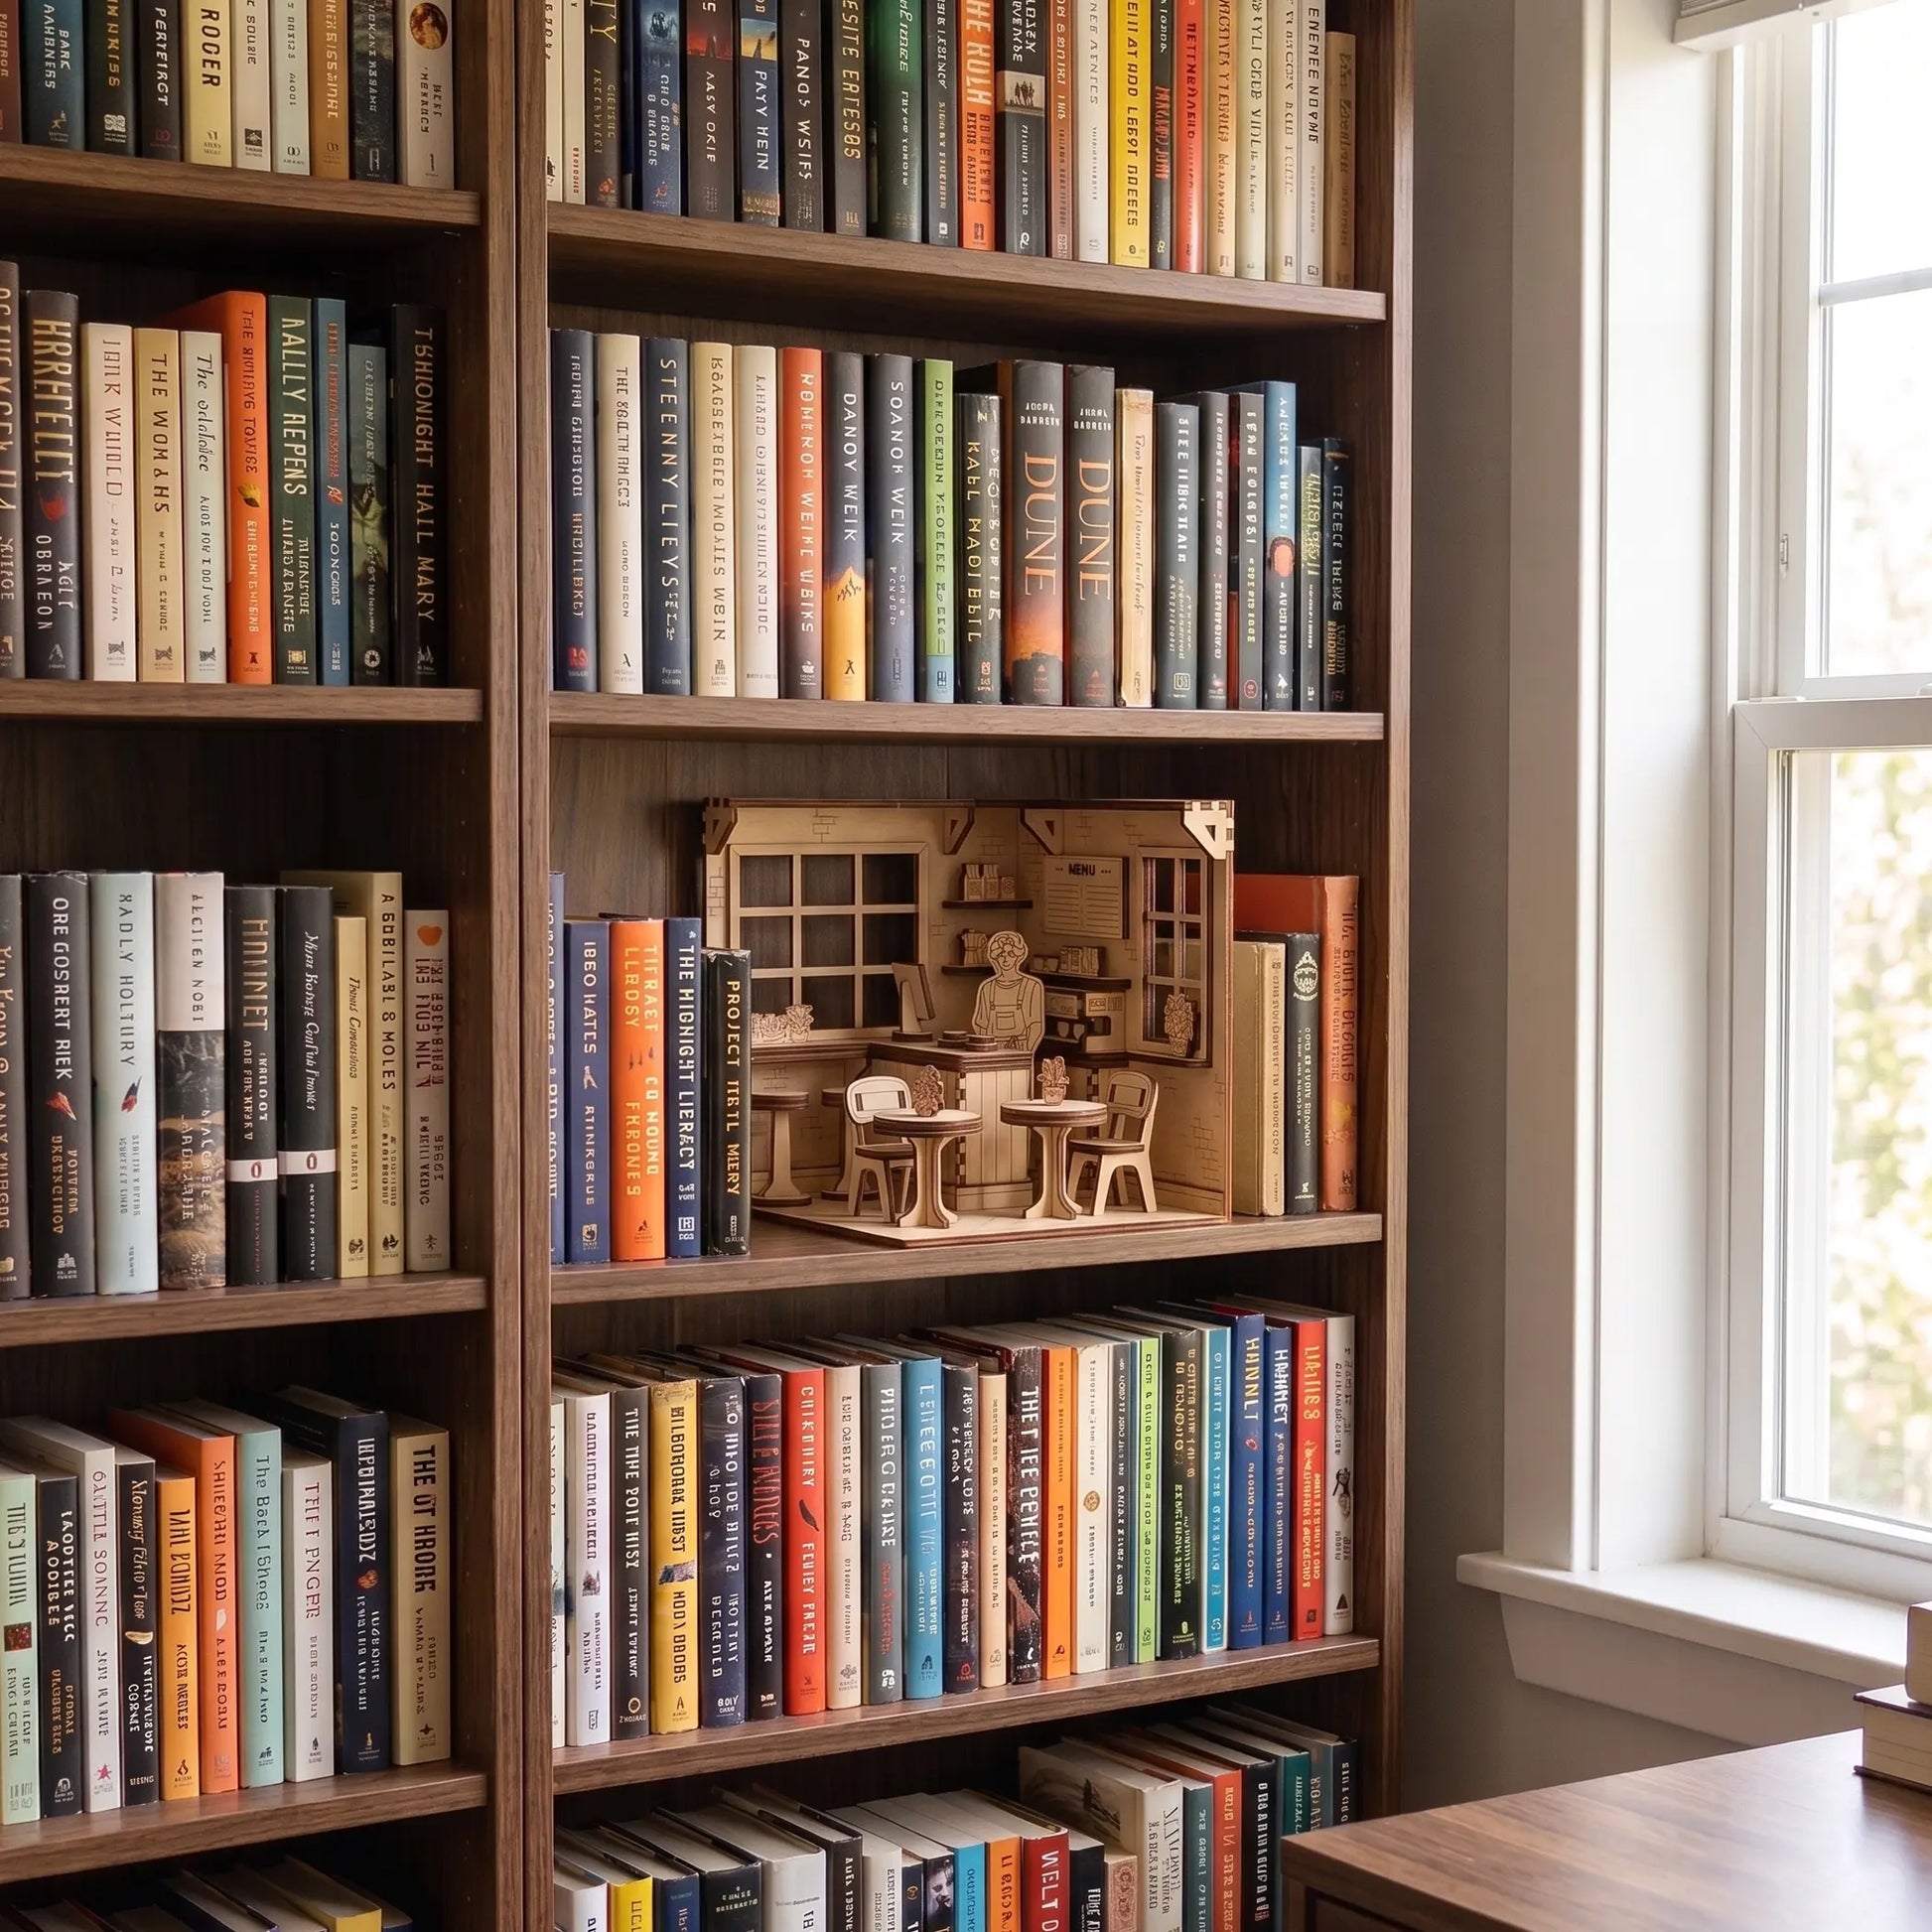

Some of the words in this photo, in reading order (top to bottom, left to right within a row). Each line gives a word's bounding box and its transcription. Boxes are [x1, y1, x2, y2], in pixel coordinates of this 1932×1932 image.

[415, 483, 435, 543] HAIL
[1024, 451, 1057, 596] DUNE
[1078, 458, 1111, 601] DUNE
[416, 556, 435, 621] MARY
[1069, 864, 1095, 876] MENU
[678, 946, 695, 980] THE
[727, 981, 741, 1066] PROJECT
[382, 1032, 397, 1091] MOLES
[255, 1455, 270, 1487] The
[413, 1446, 436, 1486] THE
